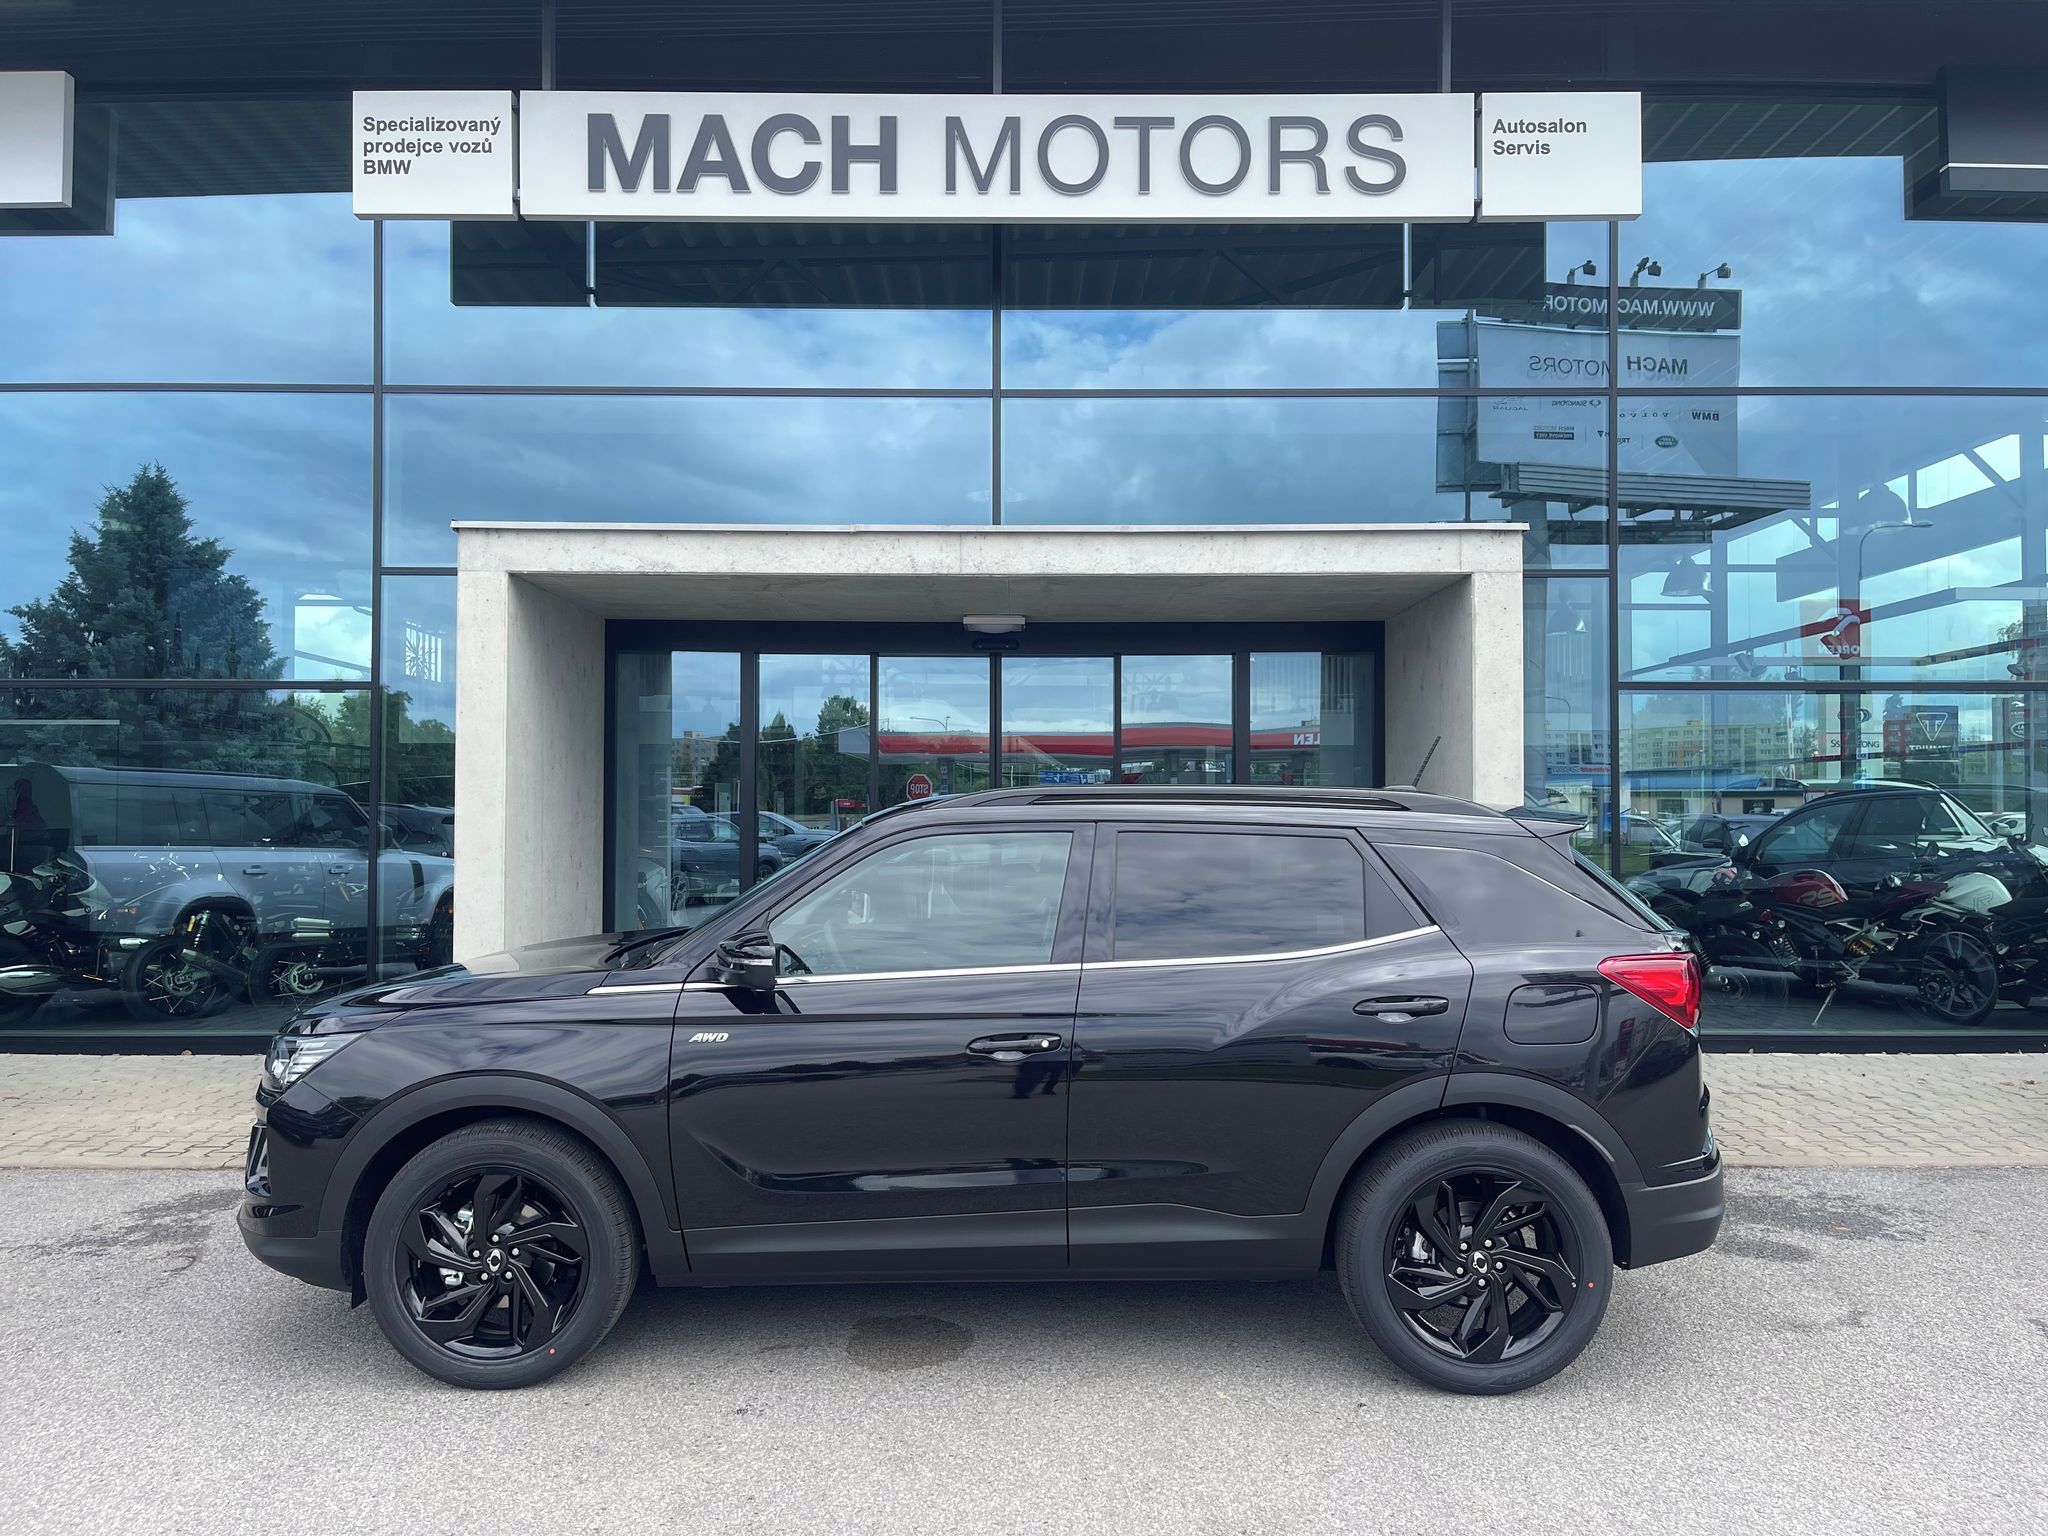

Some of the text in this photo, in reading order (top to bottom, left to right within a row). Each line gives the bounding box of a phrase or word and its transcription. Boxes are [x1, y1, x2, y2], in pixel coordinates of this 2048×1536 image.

[363, 117, 501, 136] Specializovaný
[1493, 118, 1587, 134] Autosalon
[363, 138, 493, 157] prodejce vozů
[587, 113, 1407, 196] MACH MOTORS
[1493, 140, 1551, 155] Servis
[363, 160, 412, 175] BMW
[688, 1032, 729, 1043] AWD
